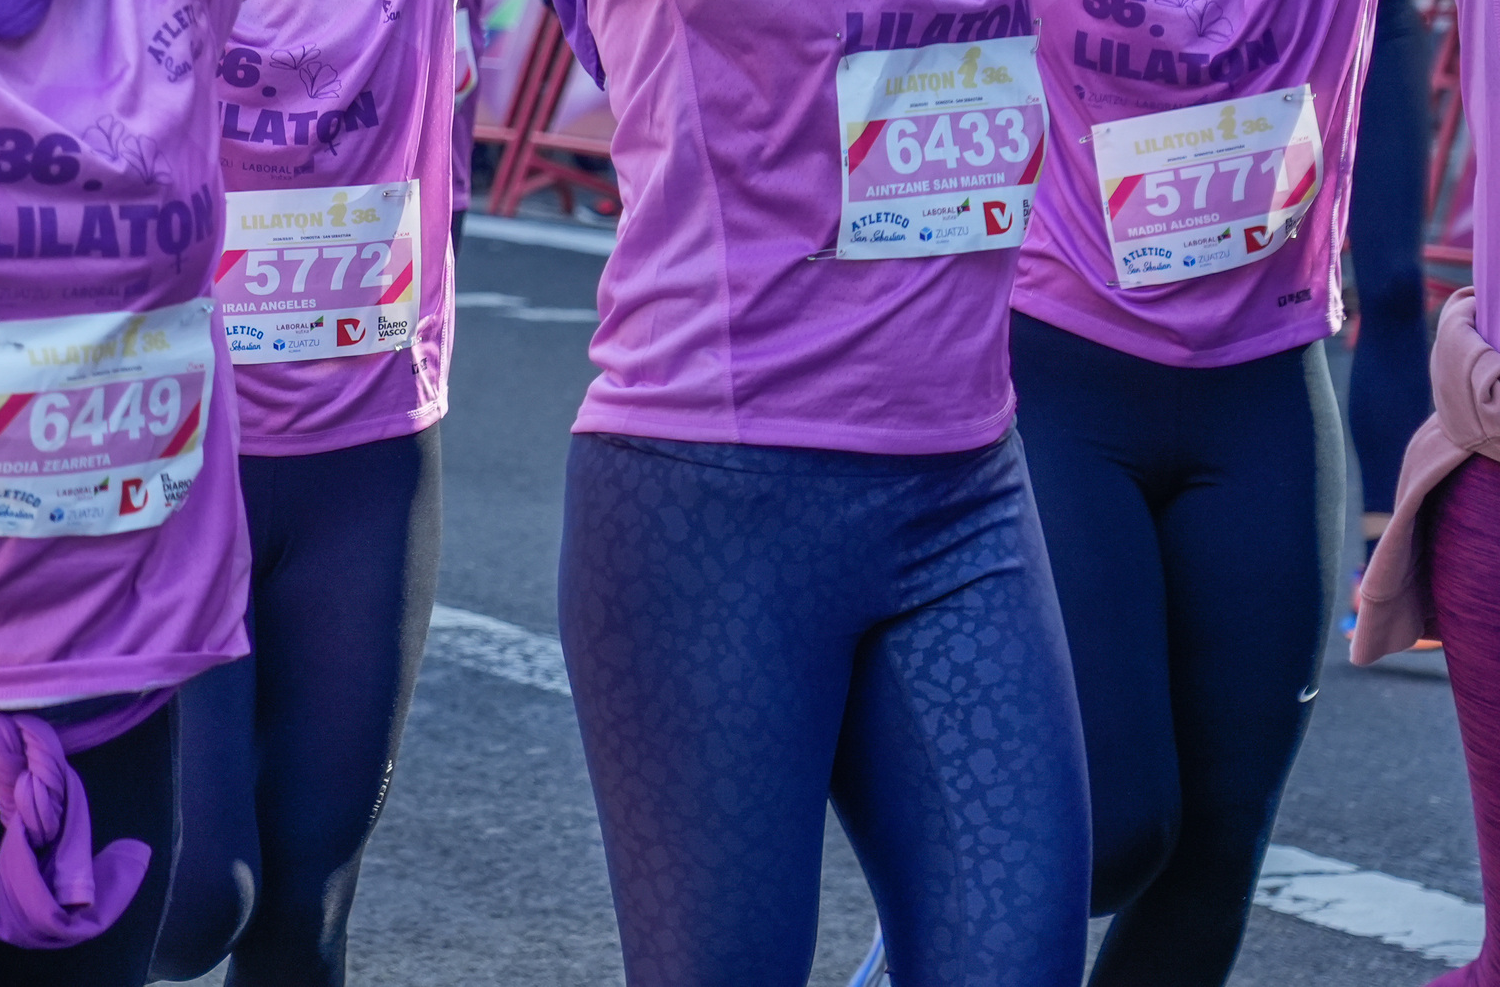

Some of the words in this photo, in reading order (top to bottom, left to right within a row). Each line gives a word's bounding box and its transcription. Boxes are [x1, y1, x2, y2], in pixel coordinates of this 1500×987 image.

[1073, 28, 1281, 86] LILATON
[885, 70, 955, 97] LILATON
[885, 107, 1030, 175] 6433
[1134, 127, 1215, 156] LILATON
[242, 161, 292, 174] LABORAL
[865, 178, 930, 198] AINTZANE
[933, 176, 958, 191] SAN
[960, 172, 1006, 188] MARTIN
[1144, 146, 1290, 217] 5771
[241, 211, 324, 232] LILATON
[851, 211, 910, 233] ATLETICO
[922, 206, 956, 218] LABORAL
[935, 226, 969, 238] ZUATZU
[1127, 222, 1167, 238] MADDI
[1170, 212, 1220, 231] ALONSO
[850, 230, 867, 243] San
[1183, 236, 1216, 248] LABORAL
[1122, 247, 1173, 267] ATLETICO
[1198, 249, 1231, 263] ZUATZU
[244, 242, 393, 296] 5772
[222, 302, 257, 313] IRAIA
[260, 298, 317, 311] ANGELES
[276, 323, 310, 331] LABORAL
[378, 316, 388, 324] EL
[378, 321, 408, 331] DIARIO
[378, 328, 407, 338] VASCO
[288, 339, 321, 349] ZUATZU
[29, 377, 182, 453] 6449
[41, 453, 111, 473] ZEARRETA
